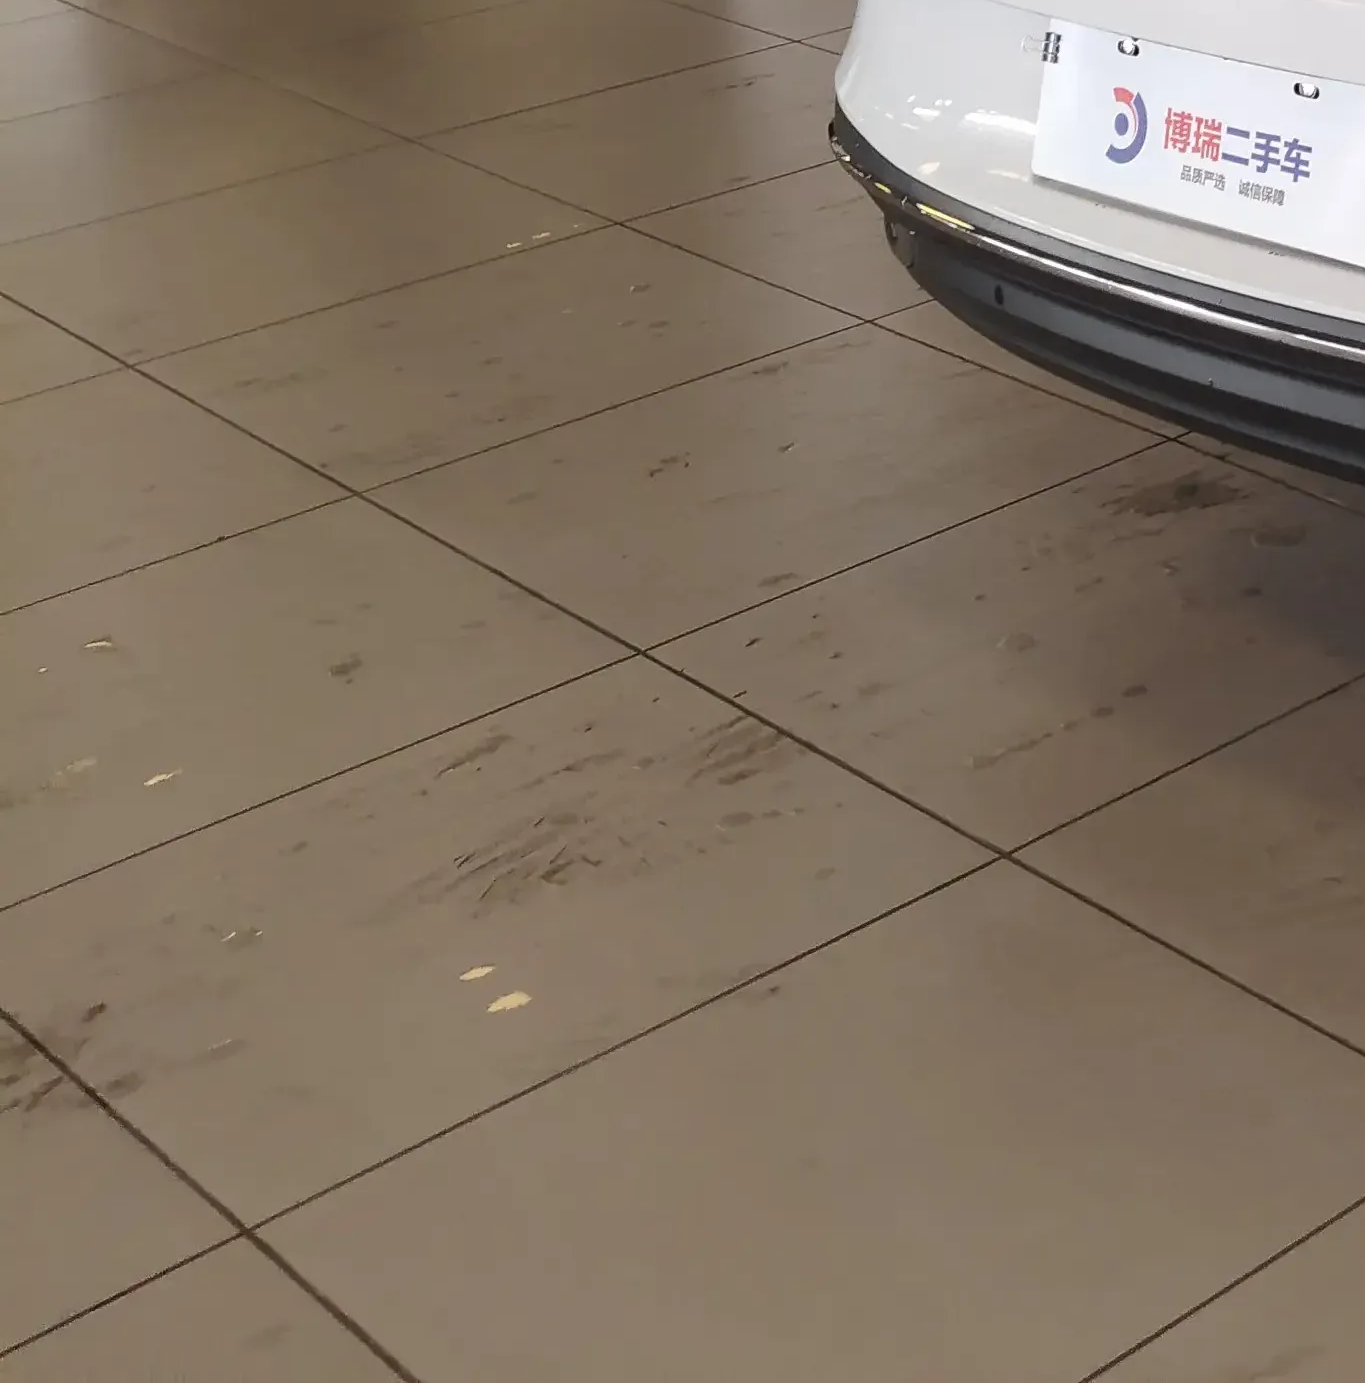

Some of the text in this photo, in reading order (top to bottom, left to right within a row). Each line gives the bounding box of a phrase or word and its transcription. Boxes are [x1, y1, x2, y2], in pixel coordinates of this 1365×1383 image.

[1163, 107, 1313, 183] 博瑞二手车
[1180, 164, 1286, 206] 品质严选 诚信保障
